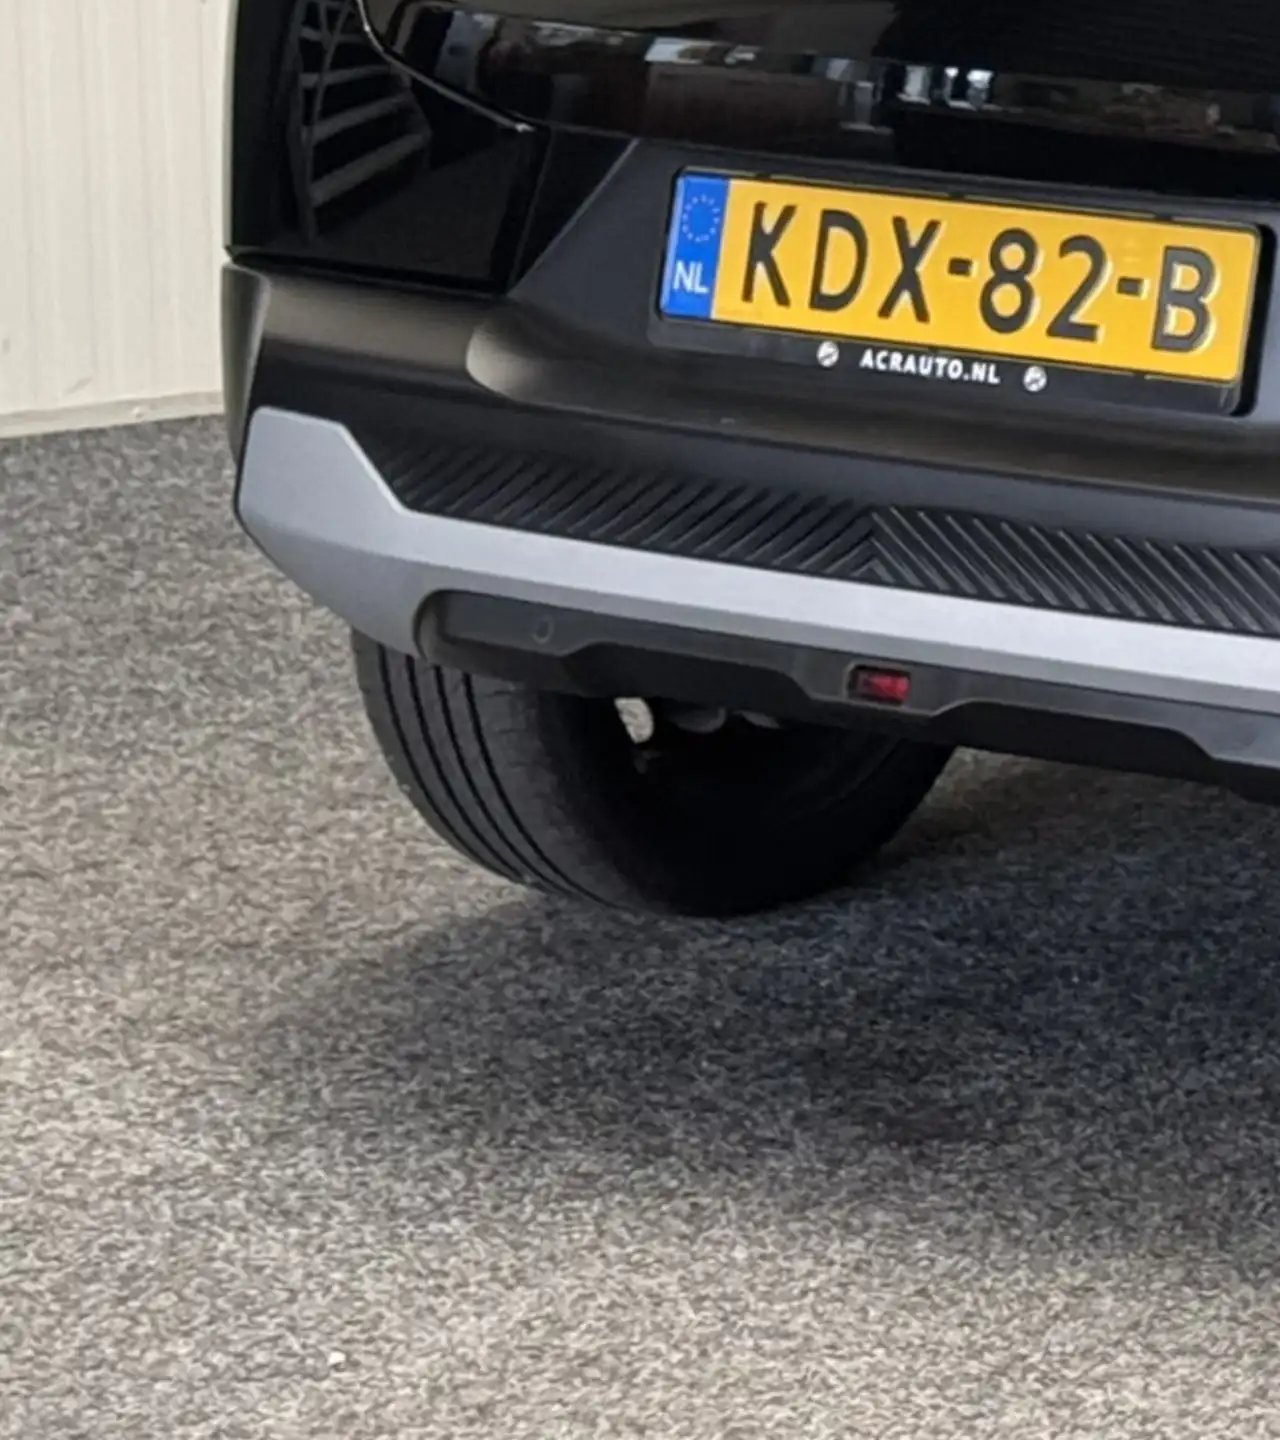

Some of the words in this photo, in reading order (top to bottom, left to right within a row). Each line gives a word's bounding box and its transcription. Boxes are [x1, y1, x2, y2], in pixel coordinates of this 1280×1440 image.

[673, 260, 709, 294] NL
[741, 201, 1216, 353] KDX-82-B
[859, 347, 1001, 385] ACRAUTO.NL
